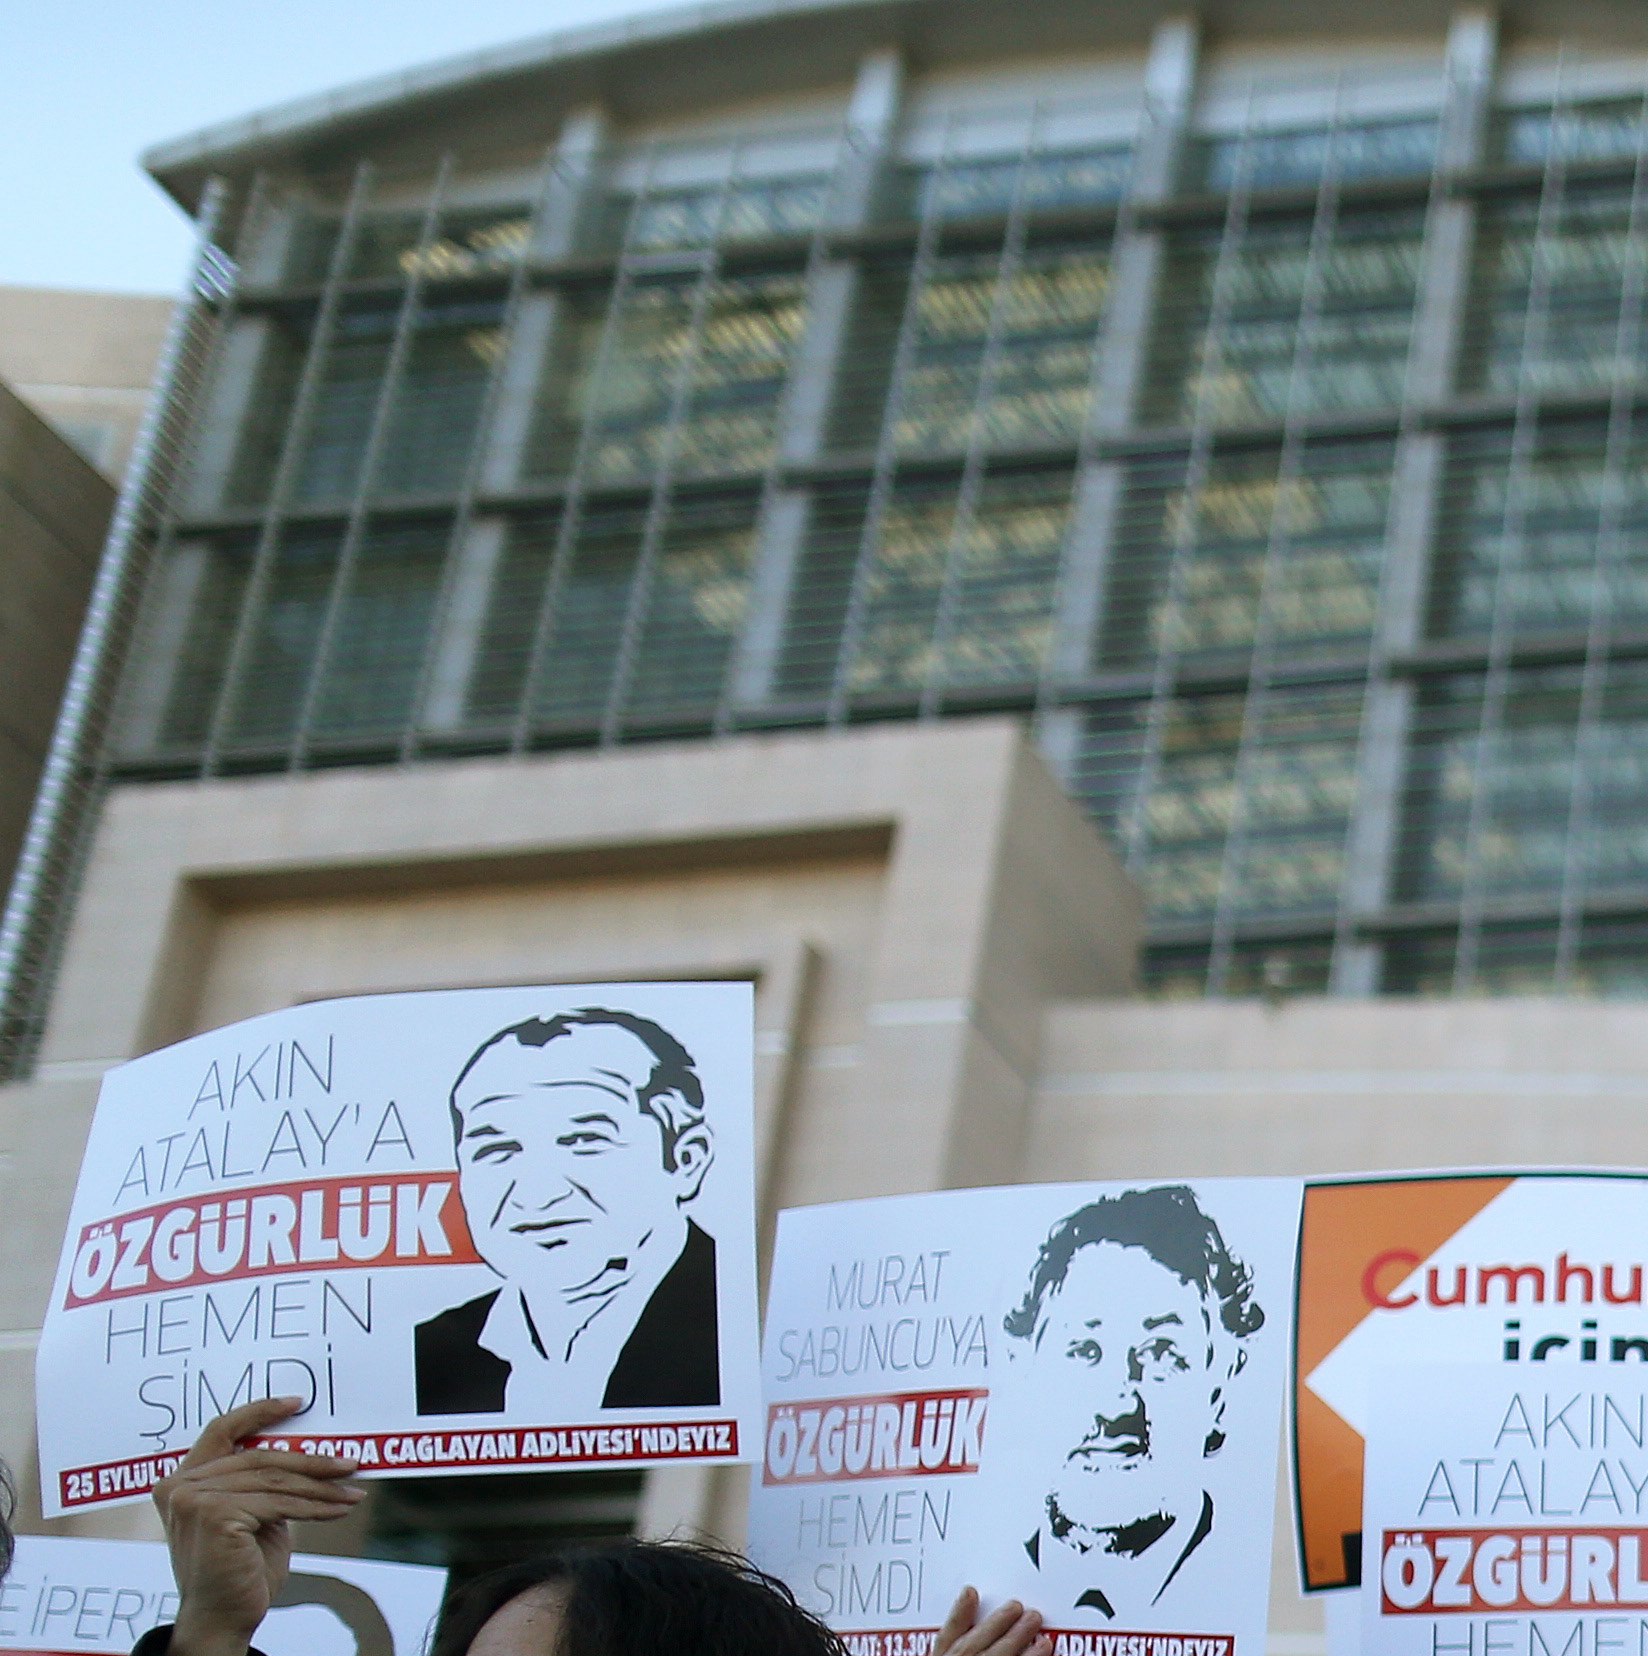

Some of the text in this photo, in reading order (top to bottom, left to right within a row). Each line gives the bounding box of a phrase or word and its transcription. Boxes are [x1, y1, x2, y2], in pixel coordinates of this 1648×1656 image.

[187, 1034, 334, 1120] AKIN
[114, 1100, 415, 1205] ATALAY'A
[70, 1178, 453, 1301] ÖZGÜRLÜK
[105, 1278, 373, 1364] HEMEN
[827, 1250, 951, 1312] MURAT
[776, 1314, 988, 1383] SABUNCU'YA
[139, 1342, 336, 1452] ŞİMDİ
[767, 1397, 986, 1479] ÖZGÜRLÜK
[1494, 1393, 1644, 1450] AKIN
[66, 1473, 92, 1499] 25
[384, 1432, 516, 1466] ÇAĞLAYAN
[800, 1490, 950, 1549] HEMEN
